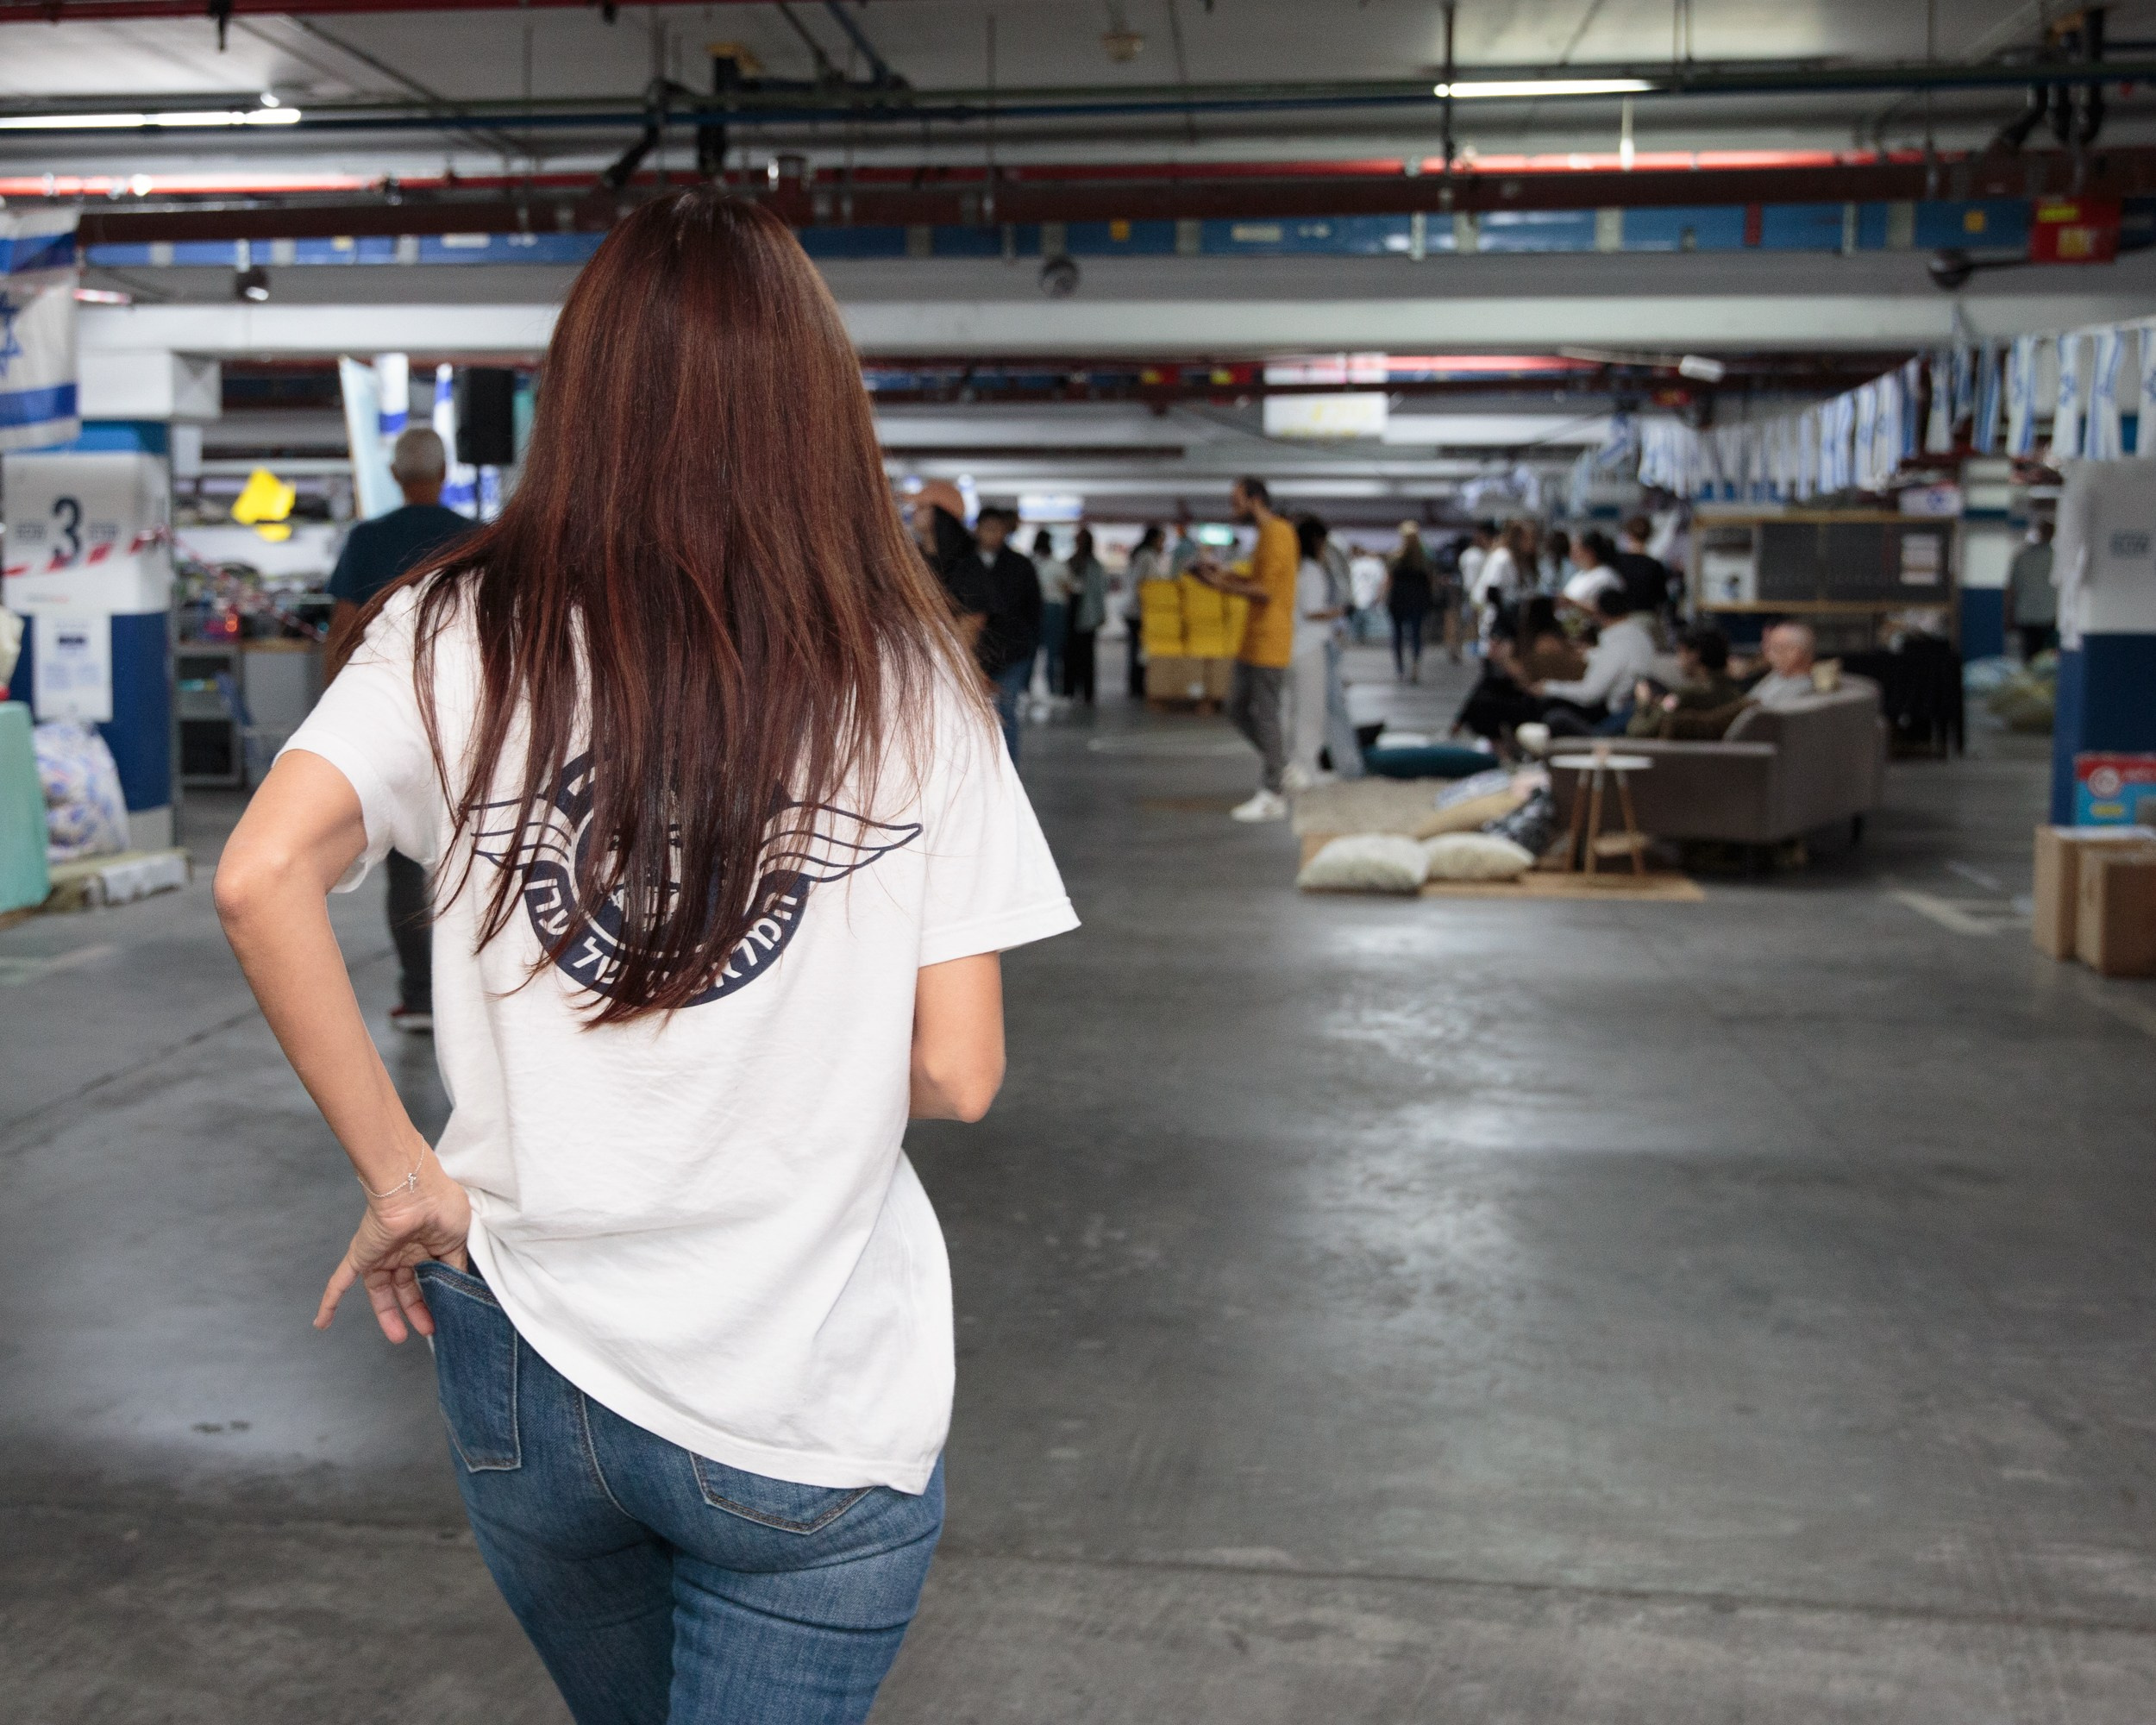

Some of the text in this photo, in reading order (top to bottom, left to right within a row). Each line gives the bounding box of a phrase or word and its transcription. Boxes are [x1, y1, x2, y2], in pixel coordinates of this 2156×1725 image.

[53, 495, 82, 568] 3
[524, 878, 798, 999] המלא של ערן
